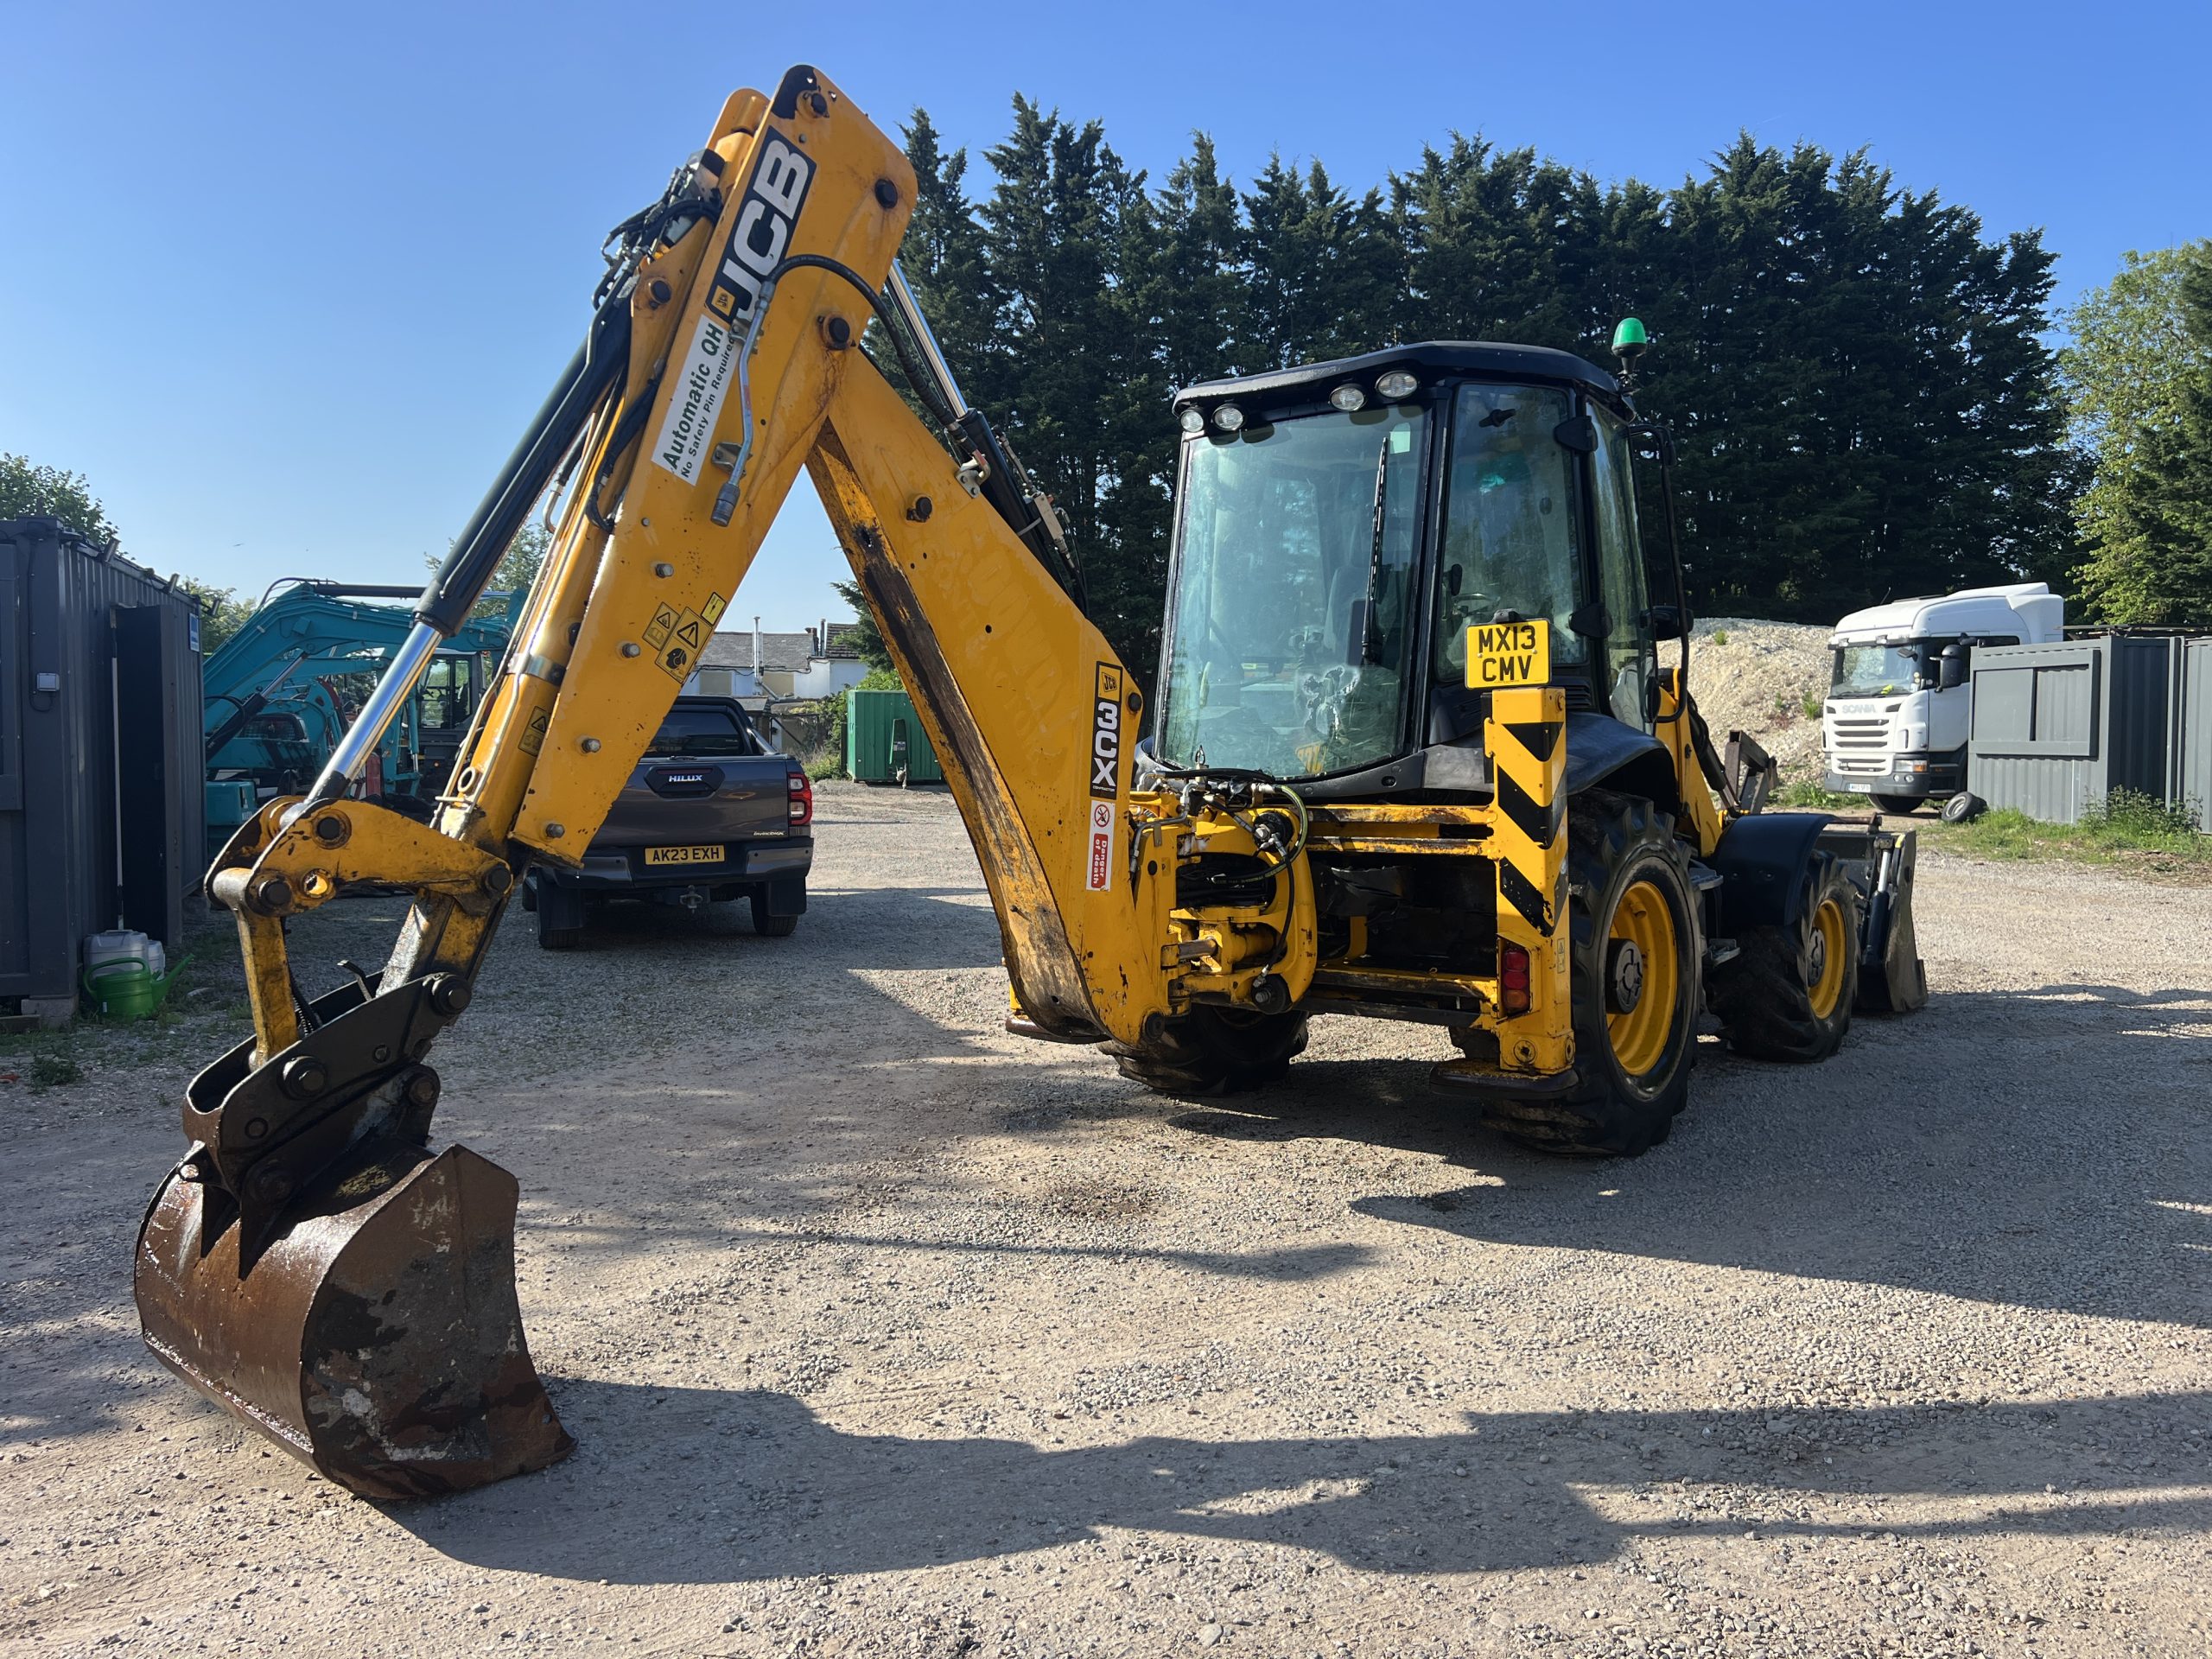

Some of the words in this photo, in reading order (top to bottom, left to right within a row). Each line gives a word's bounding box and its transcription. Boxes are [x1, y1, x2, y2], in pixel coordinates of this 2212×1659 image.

[722, 140, 809, 322] JCB
[663, 364, 710, 470] Automatic
[701, 322, 723, 356] QH
[681, 461, 693, 478] No
[689, 416, 709, 456] Safety
[703, 393, 715, 413] Pin
[1478, 625, 1535, 653] MX13
[1103, 673, 1117, 691] JCB
[1482, 655, 1532, 682] CMV
[1841, 703, 1877, 714] SCANIA
[1092, 702, 1118, 787] 3CX
[652, 849, 689, 862] AK23
[692, 847, 720, 860] EXH
[1095, 839, 1101, 849] of
